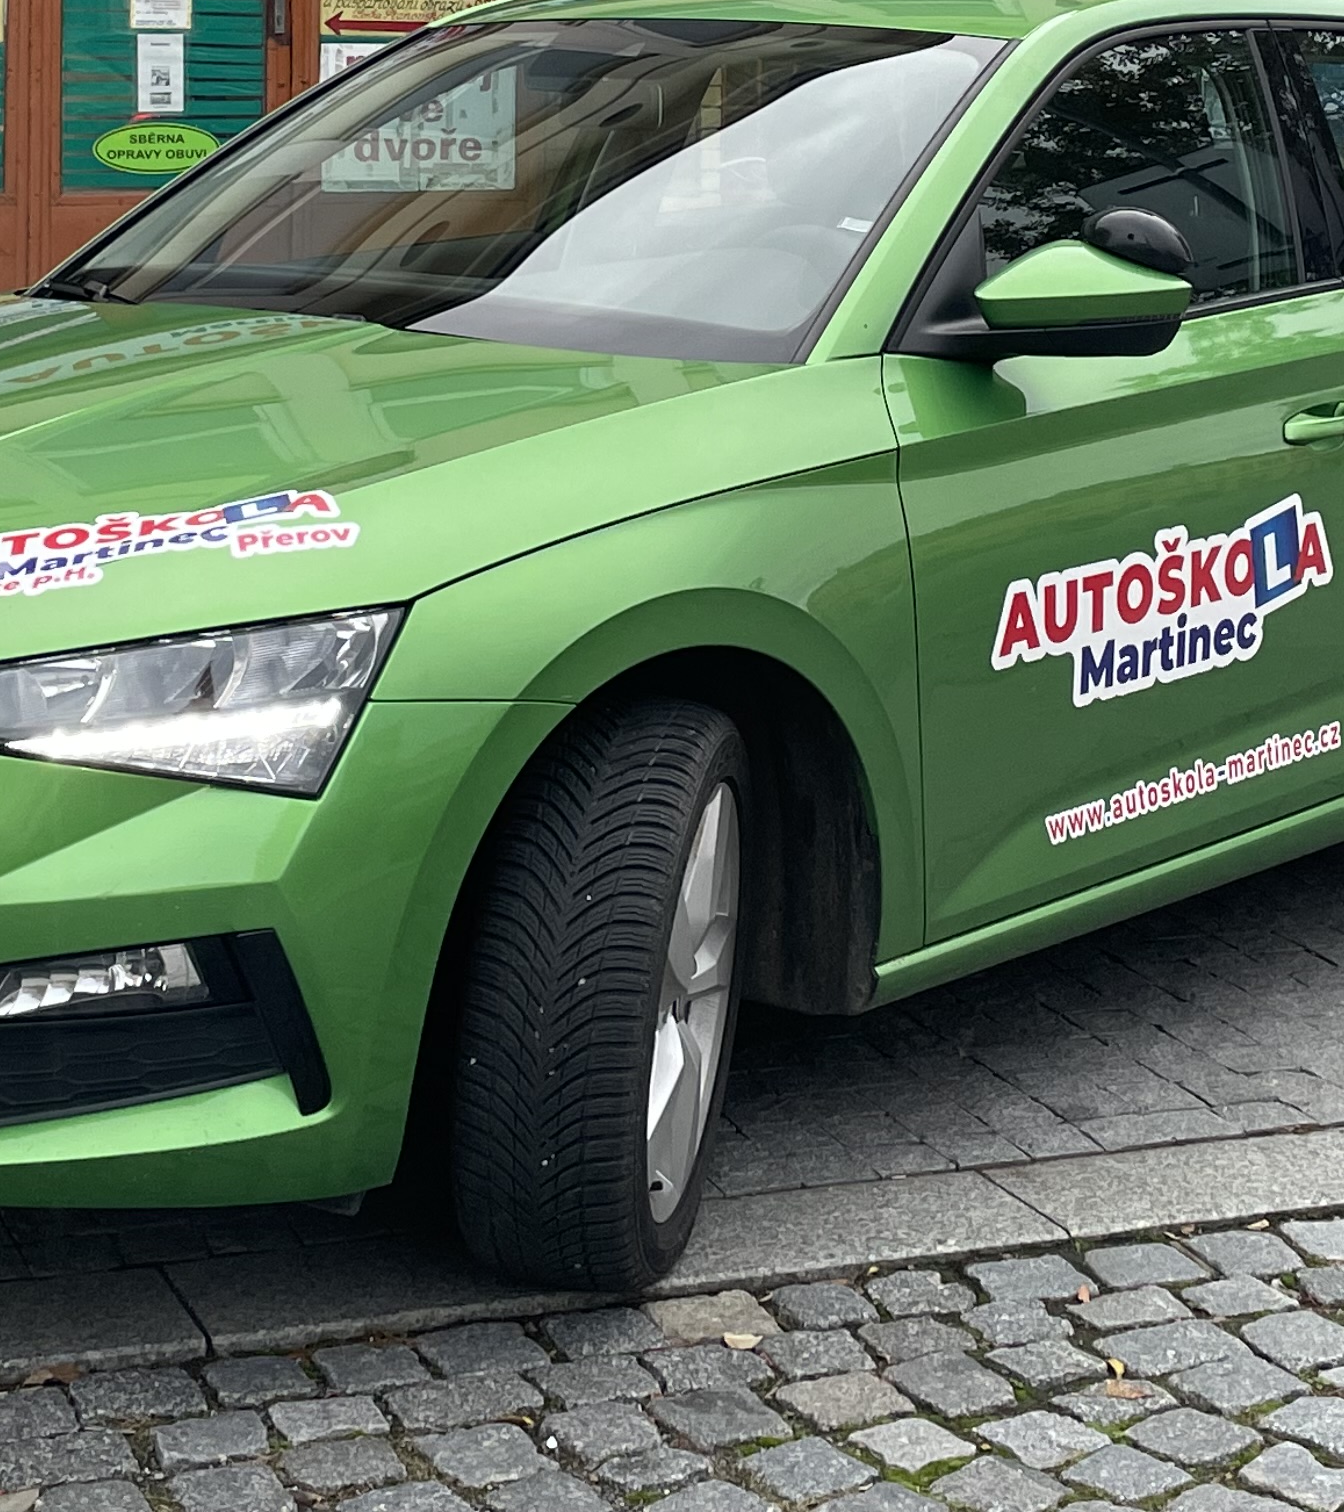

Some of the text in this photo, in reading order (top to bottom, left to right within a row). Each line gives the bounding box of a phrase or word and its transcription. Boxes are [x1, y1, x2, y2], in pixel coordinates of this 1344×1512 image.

[129, 132, 185, 144] SBĚRNA
[353, 128, 483, 163] dvoře
[107, 150, 161, 160] OPRAVY
[237, 524, 351, 553] Přerov
[32, 566, 96, 590] p.H.
[999, 505, 1328, 657] AUTOŠKOLA
[1080, 610, 1258, 695] Martinec
[1047, 725, 1339, 840] www.autoskola-martinec.cz
